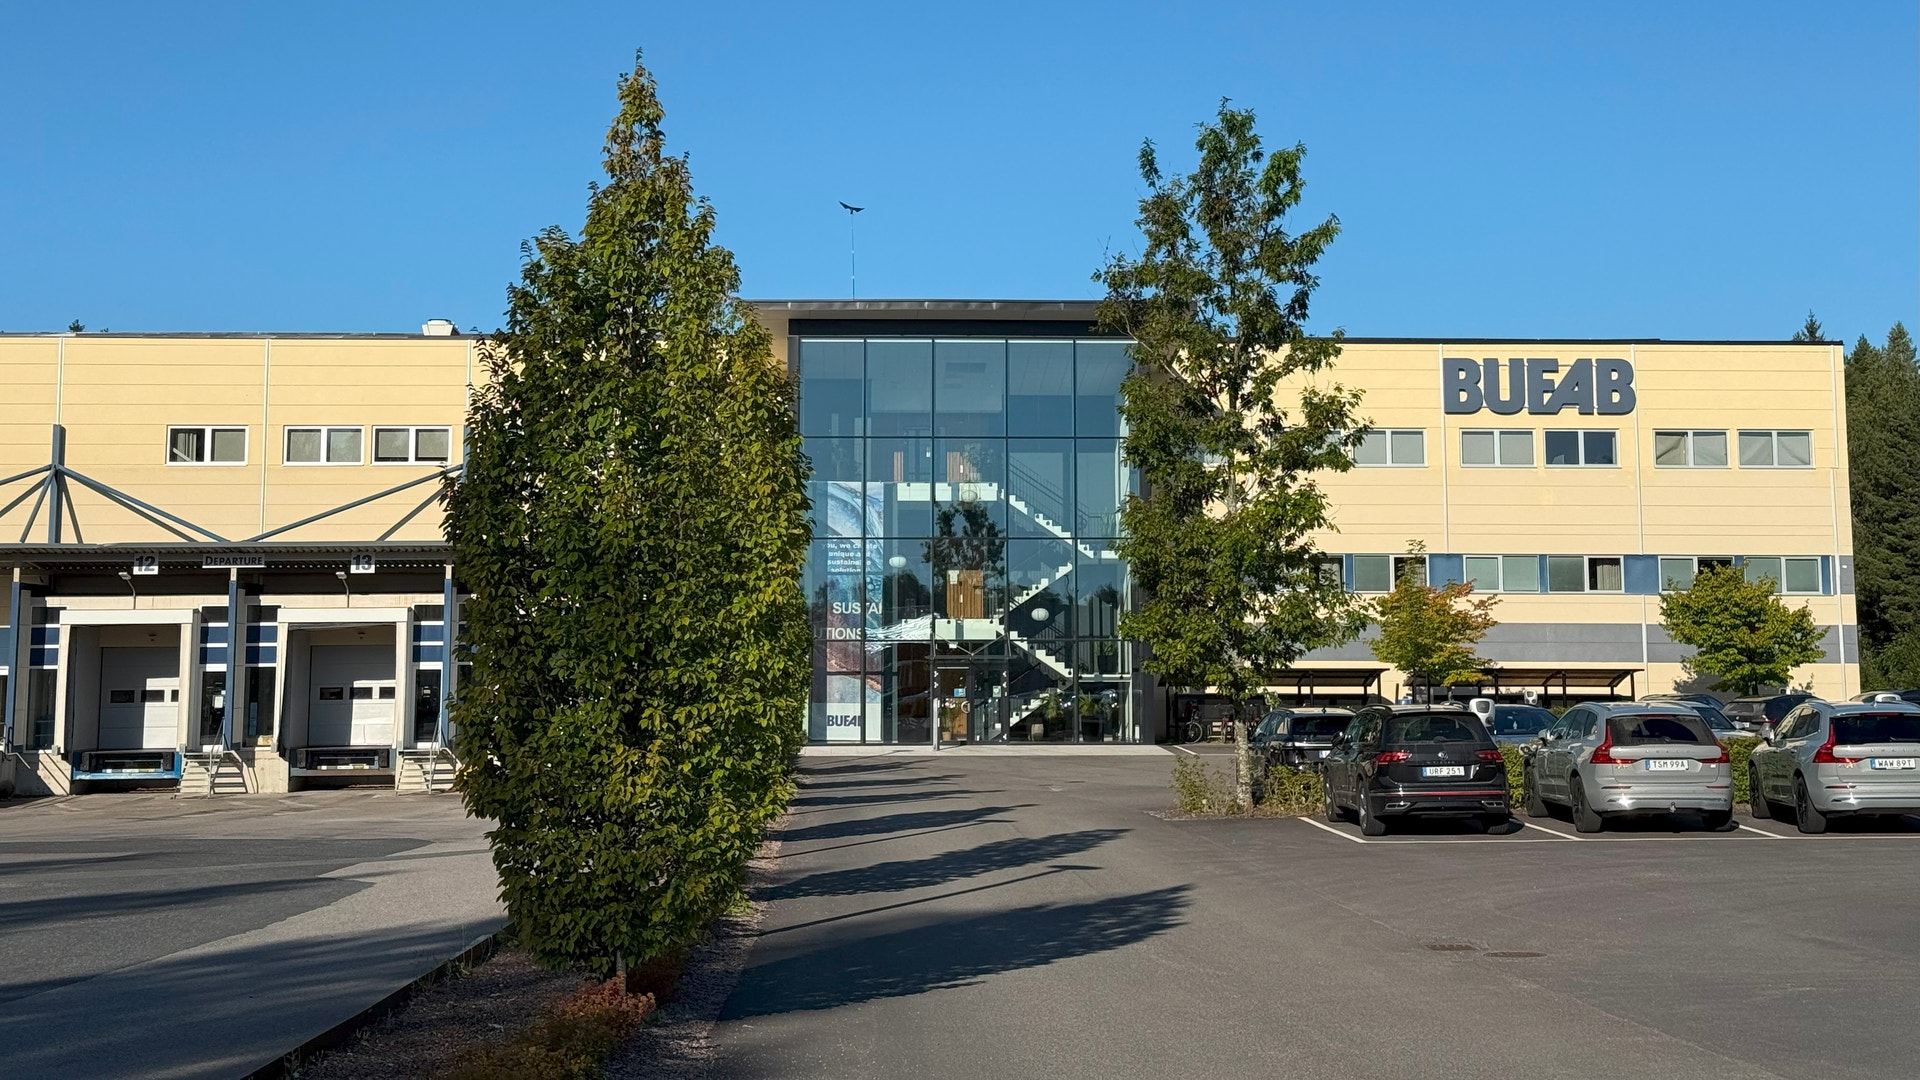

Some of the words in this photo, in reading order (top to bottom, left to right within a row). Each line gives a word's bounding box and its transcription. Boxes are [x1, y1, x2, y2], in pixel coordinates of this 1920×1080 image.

[1443, 358, 1637, 415] BUFAB
[135, 555, 156, 572] 12
[205, 556, 263, 566] DEPARTURE
[353, 554, 372, 571] 13
[827, 715, 862, 727] BUFA
[1653, 760, 1669, 768] TSM
[1670, 760, 1686, 768] 99A
[1877, 759, 1894, 767] WAW
[1429, 767, 1444, 775] URF
[1446, 767, 1462, 775] 251
